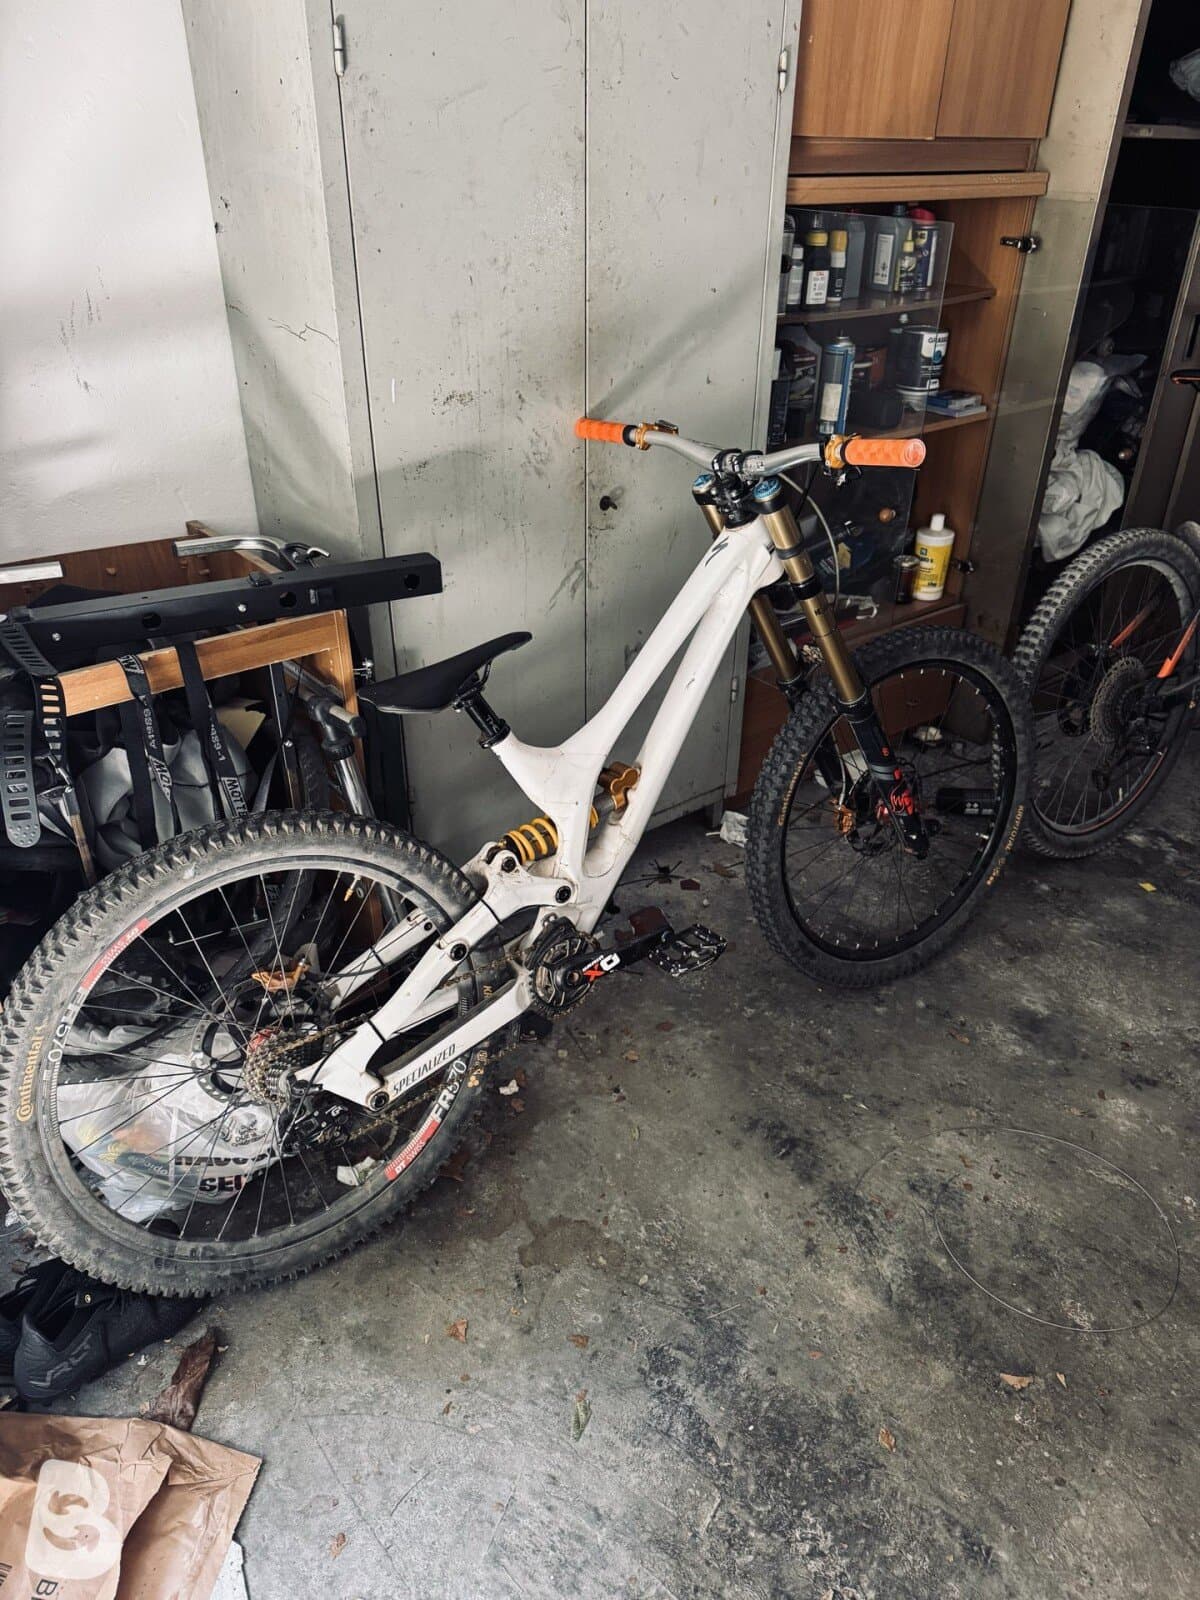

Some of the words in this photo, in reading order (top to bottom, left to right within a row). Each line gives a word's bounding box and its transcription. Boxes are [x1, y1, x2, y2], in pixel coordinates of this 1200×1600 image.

[16, 1035, 44, 1121] Continental
[393, 1043, 456, 1095] SPECIALIZED
[394, 1161, 407, 1174] DT
[407, 1140, 427, 1162] SWISS
